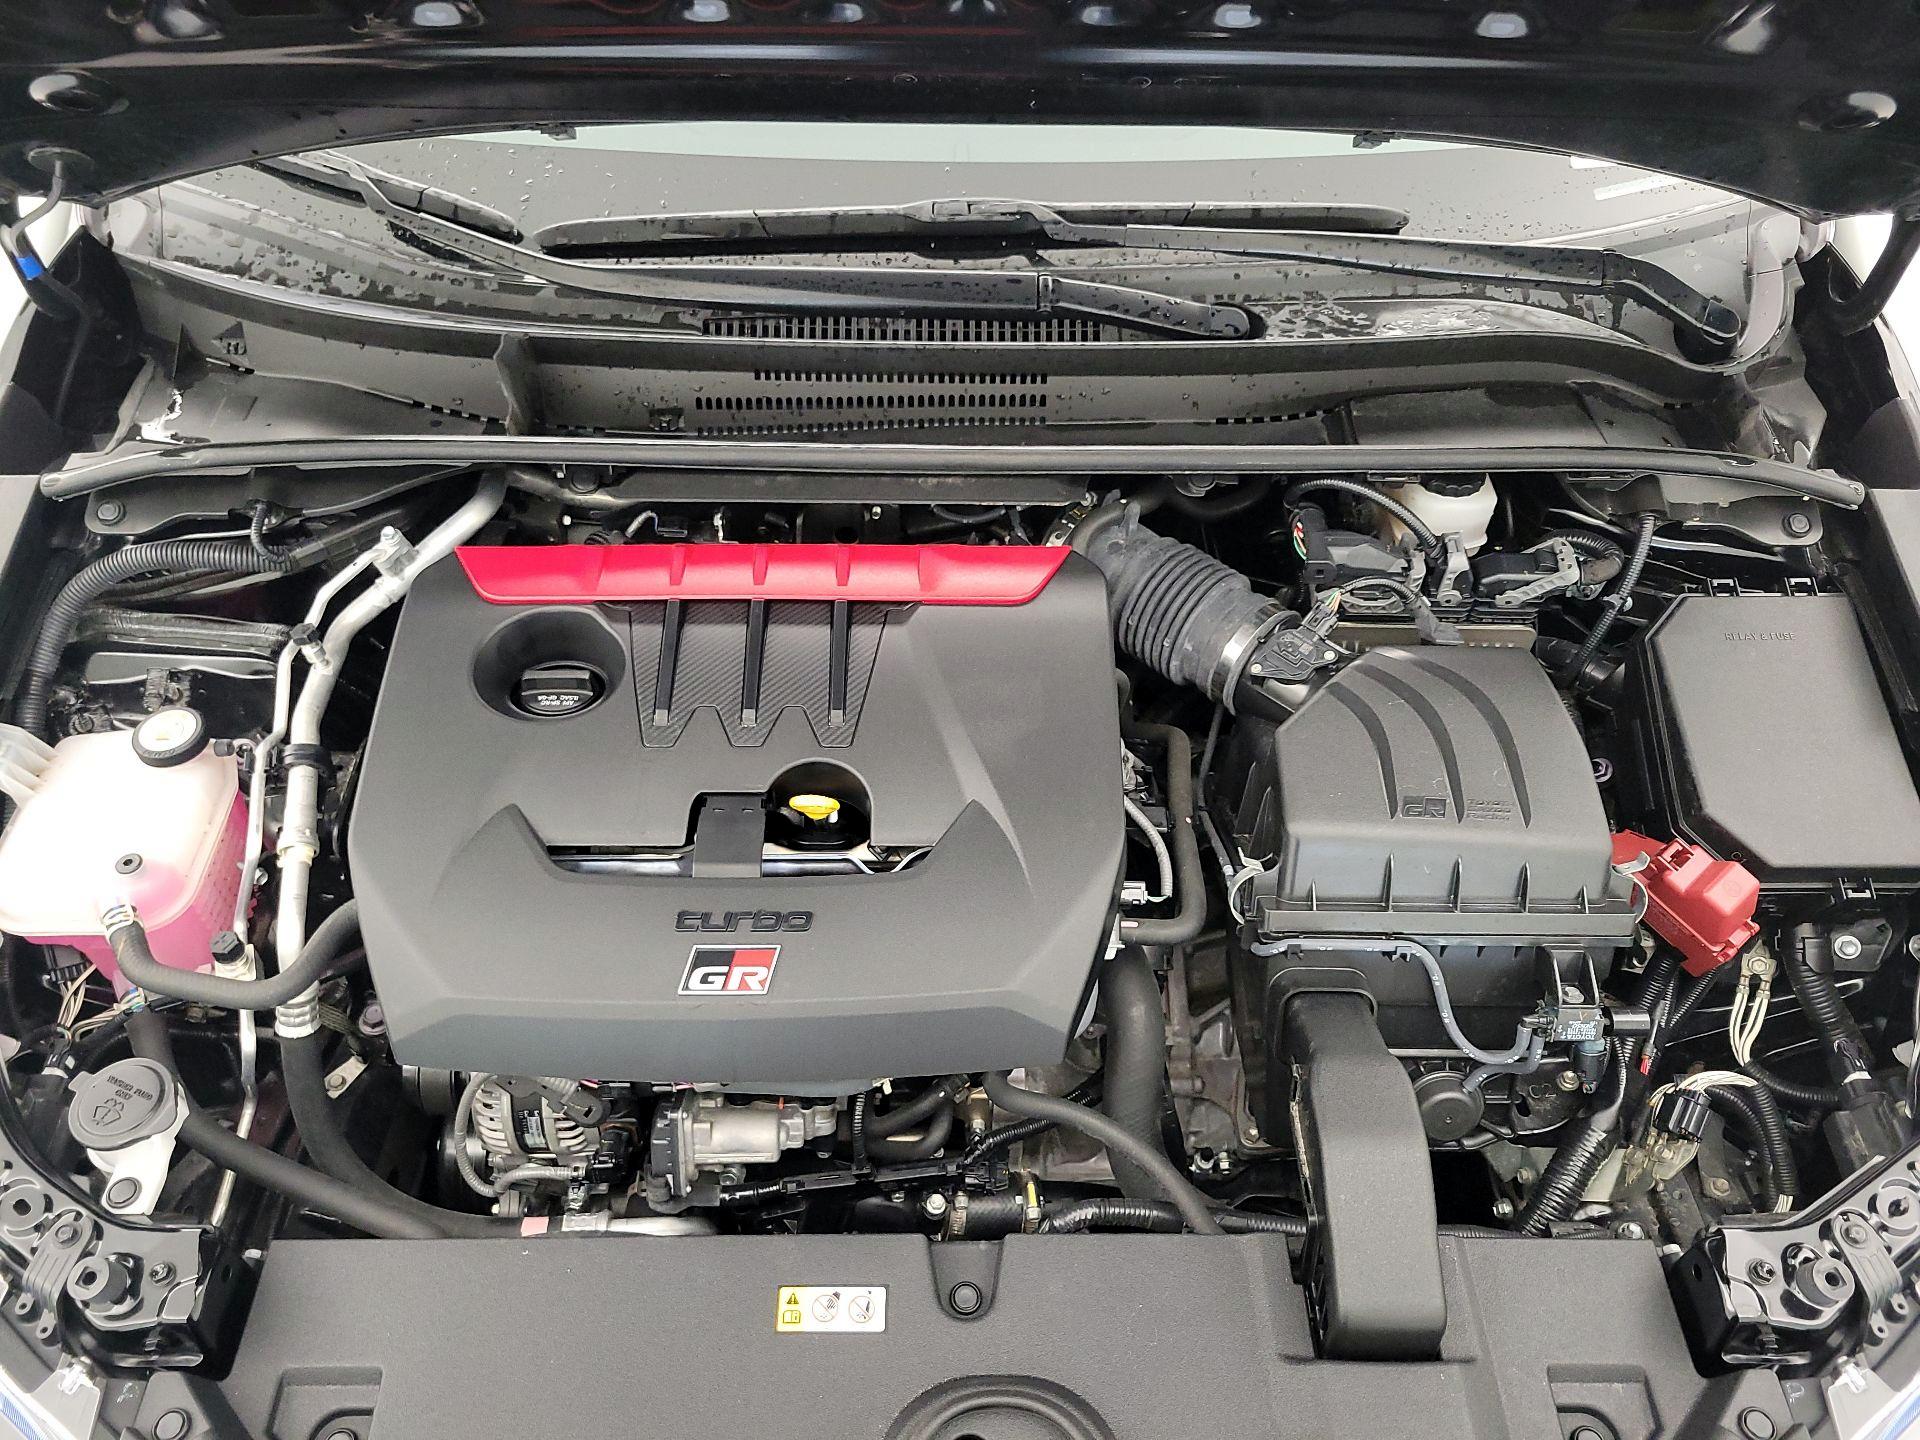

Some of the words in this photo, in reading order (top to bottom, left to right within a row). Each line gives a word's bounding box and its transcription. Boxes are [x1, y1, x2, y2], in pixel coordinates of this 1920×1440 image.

[1724, 632, 1757, 641] RELAY
[1760, 632, 1768, 641] &
[1769, 632, 1796, 641] FUSE
[674, 910, 814, 932] turbo
[687, 965, 769, 991] GR
